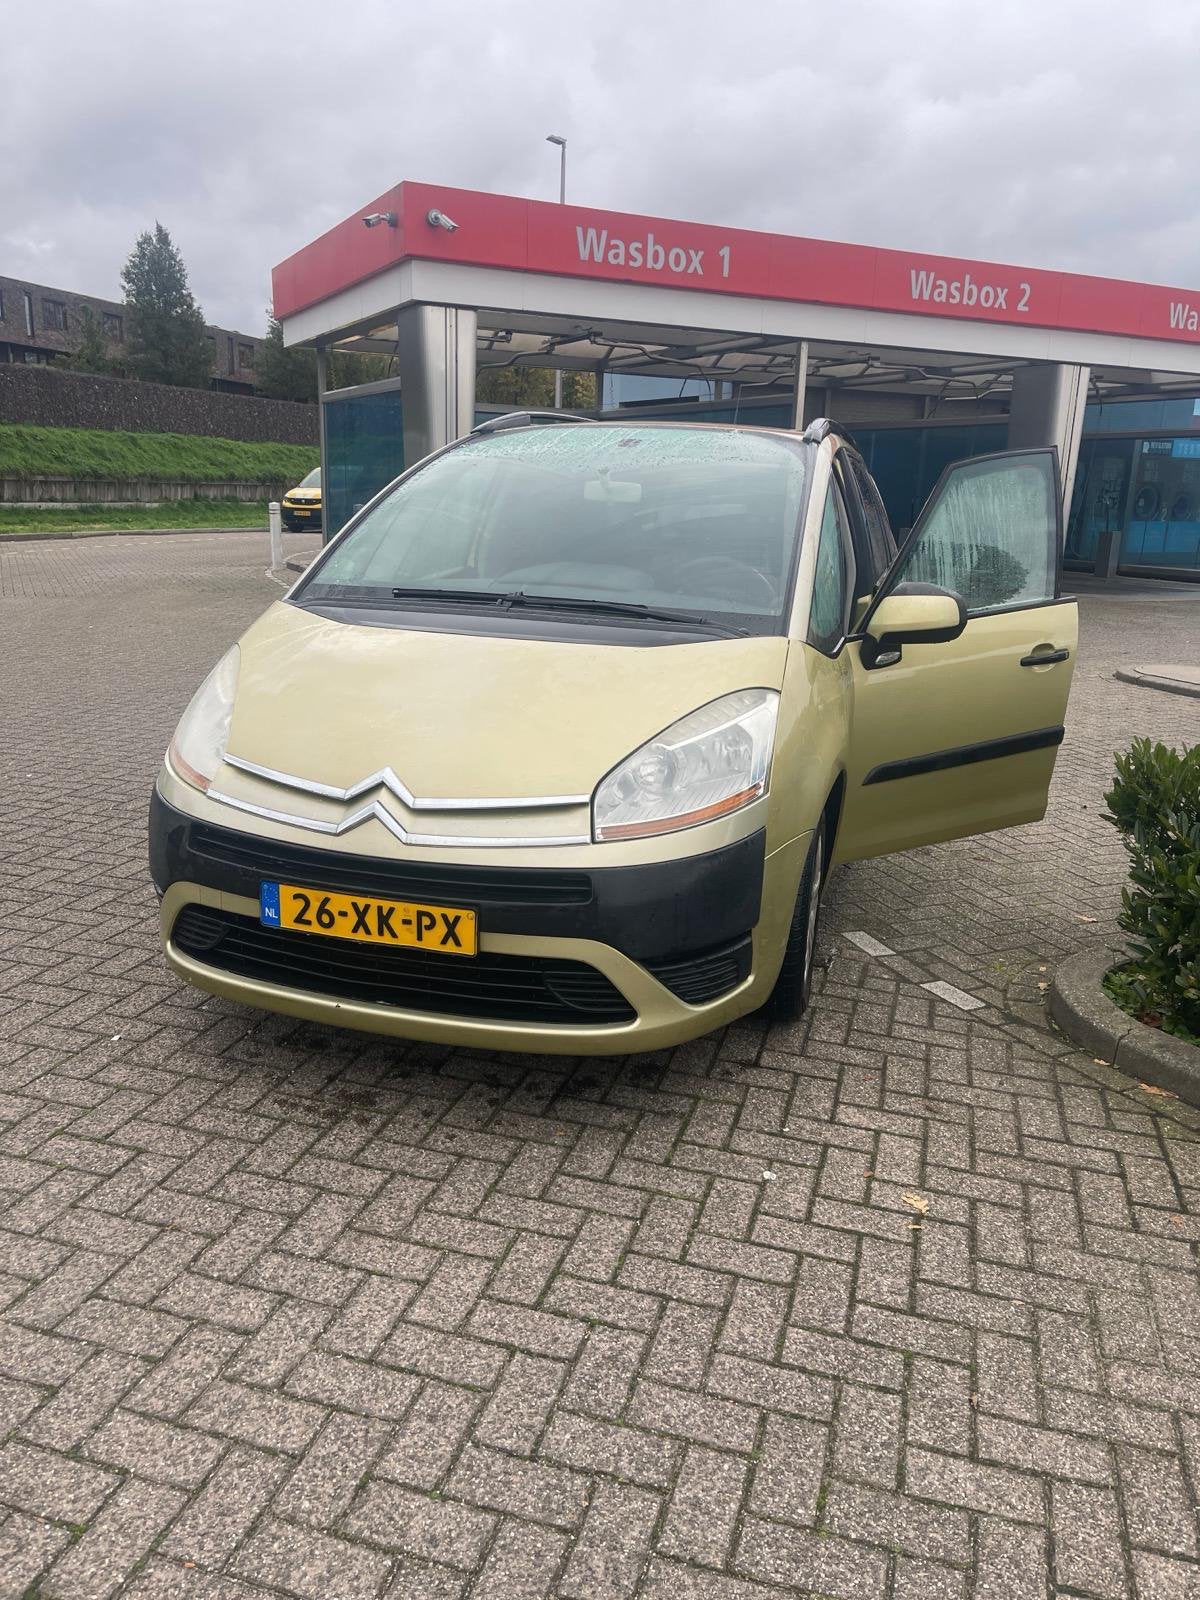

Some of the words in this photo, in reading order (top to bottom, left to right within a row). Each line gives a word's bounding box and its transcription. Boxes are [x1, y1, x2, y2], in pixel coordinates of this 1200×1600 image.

[575, 225, 704, 275] Wasbox
[718, 246, 730, 278] 1
[910, 269, 1008, 310] Wasbox
[1017, 283, 1031, 312] 2
[265, 907, 279, 919] NL
[292, 893, 462, 948] 26-XK-PX
